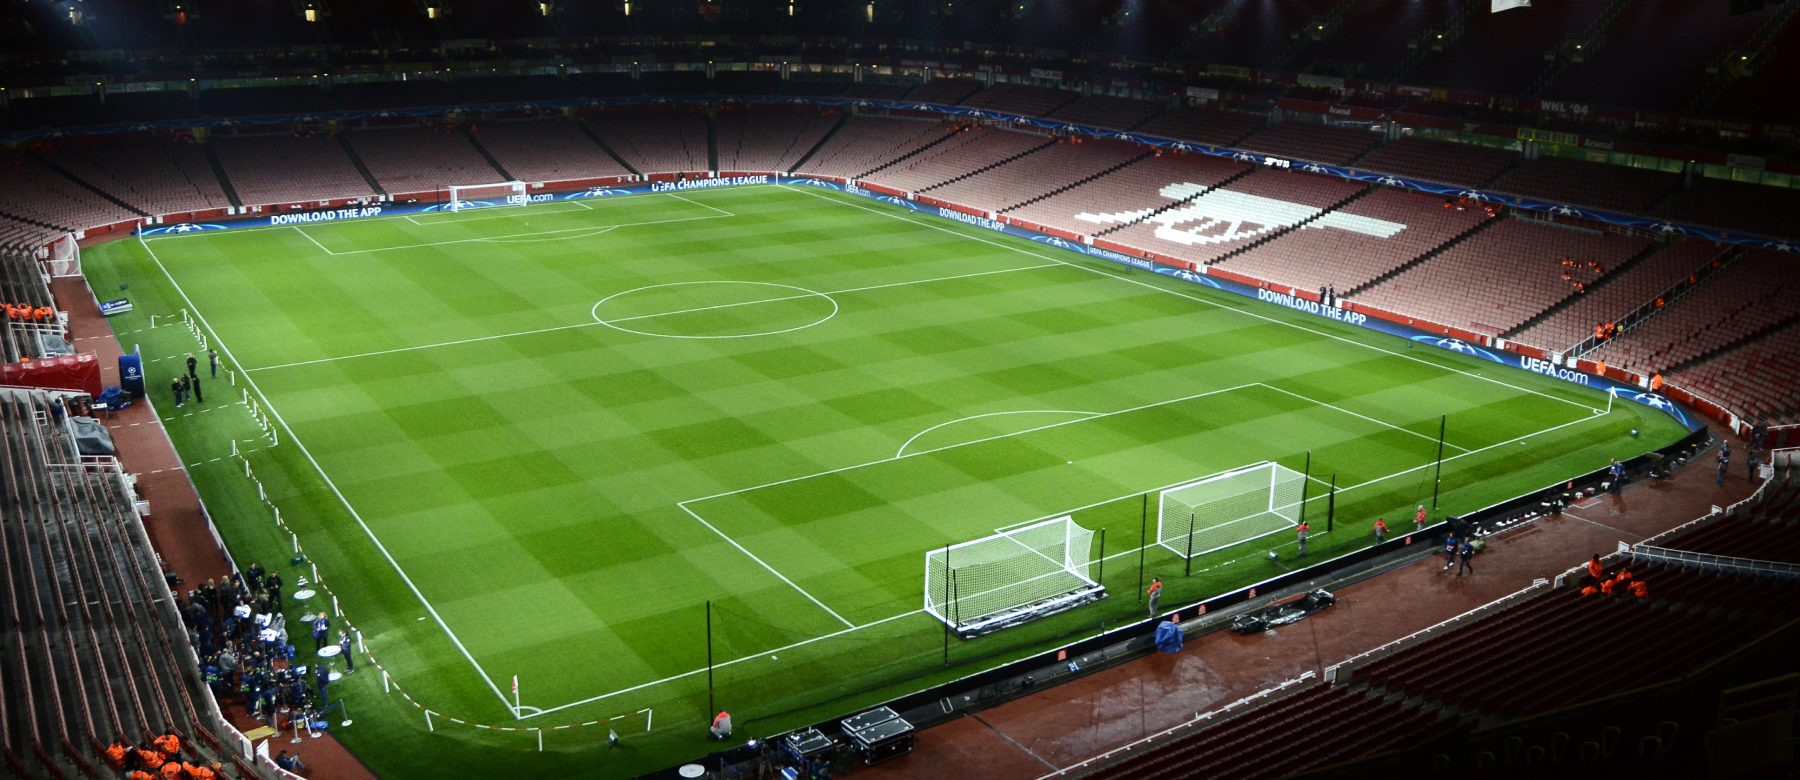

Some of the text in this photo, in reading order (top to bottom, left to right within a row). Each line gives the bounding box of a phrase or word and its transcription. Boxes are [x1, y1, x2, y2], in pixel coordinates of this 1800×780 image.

[1328, 105, 1352, 116] Arsenal
[1540, 100, 1566, 113] WHL
[1645, 113, 1669, 123] 2004
[1584, 138, 1614, 150] Arsenal
[677, 177, 730, 190] CHAMPIONS
[732, 175, 768, 186] LEAGUE
[270, 206, 382, 225] DOWNLOAD THE APP
[939, 207, 1005, 232] DOWNLOAD THE APP
[1089, 246, 1151, 268] UEFA CHAMPIONS LEAGUE
[1258, 287, 1367, 326] DOWNLOAD THE APP
[1520, 355, 1589, 385] UEFA.com
